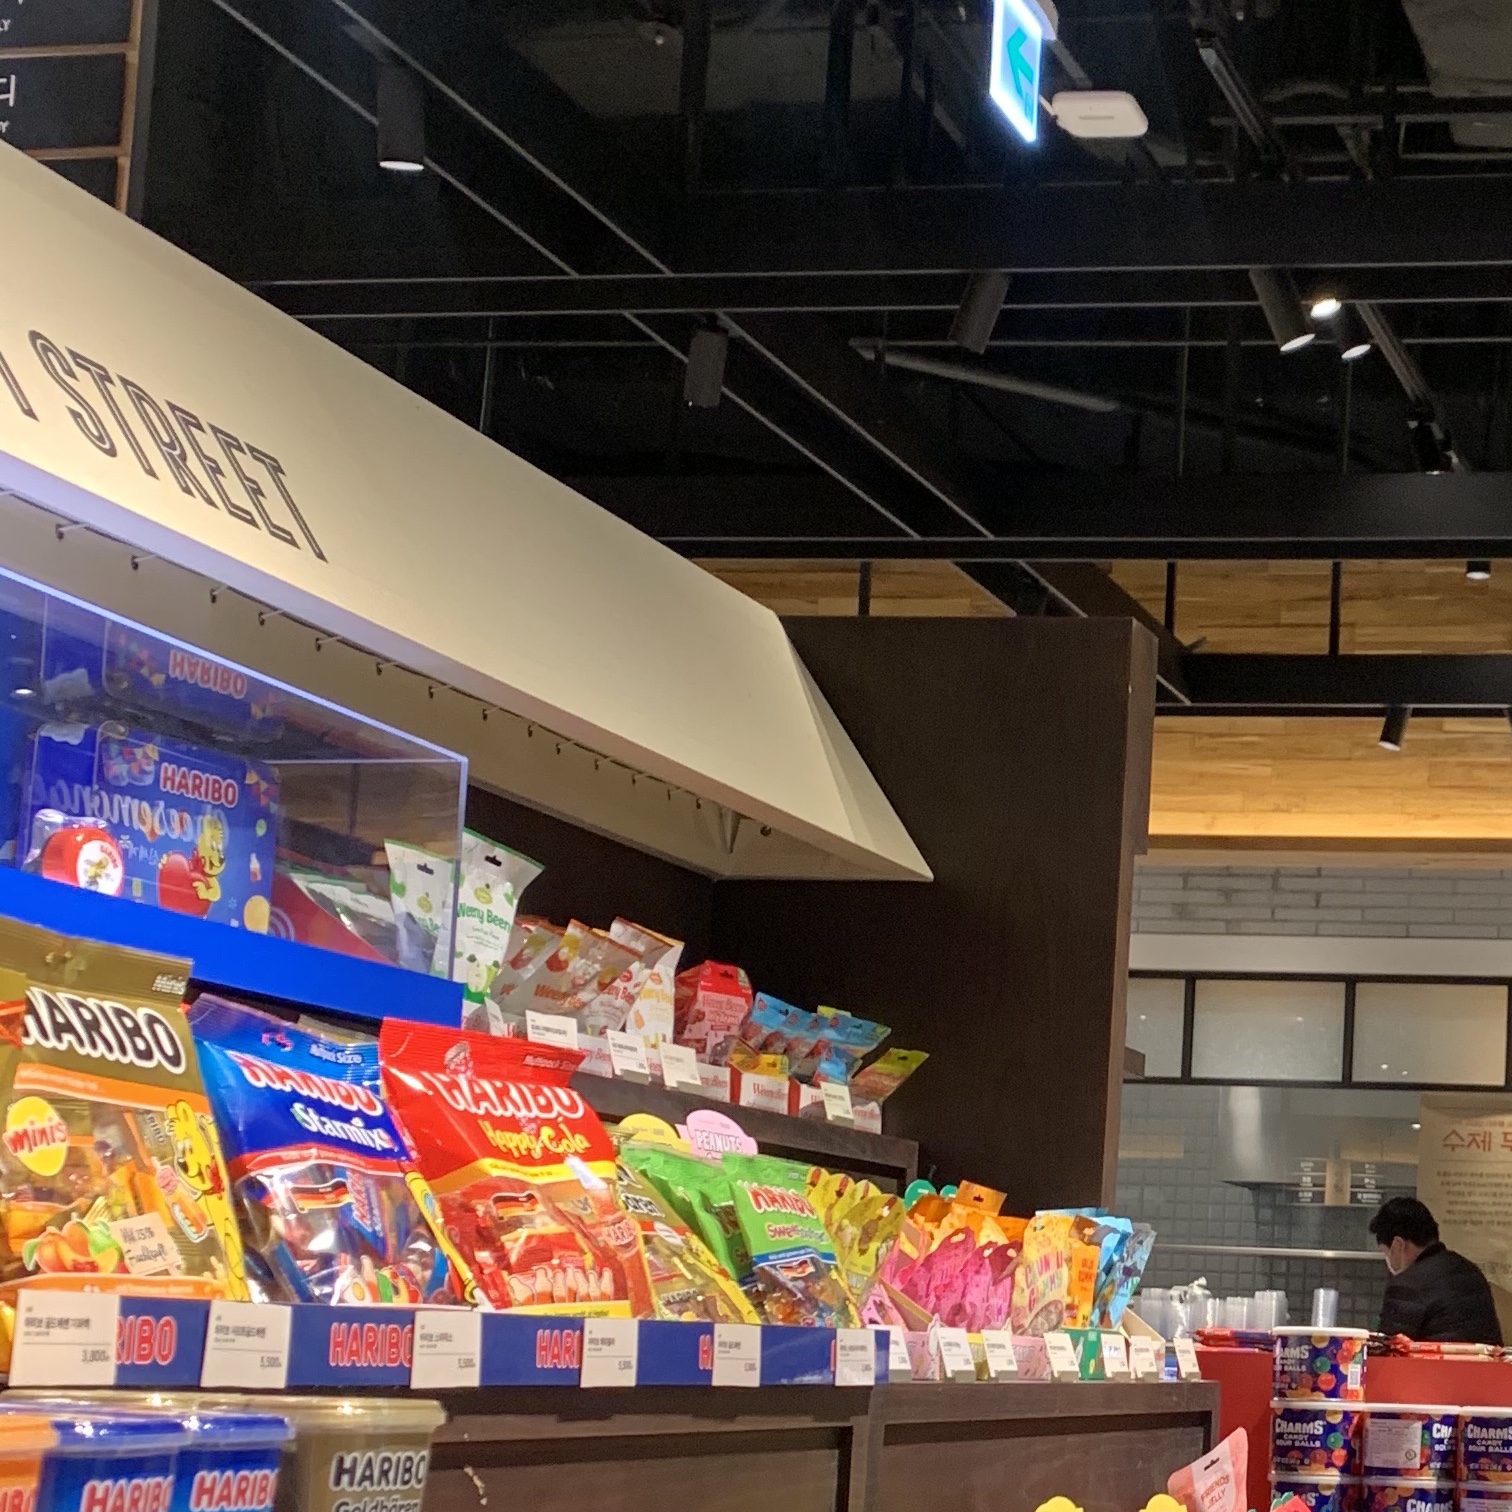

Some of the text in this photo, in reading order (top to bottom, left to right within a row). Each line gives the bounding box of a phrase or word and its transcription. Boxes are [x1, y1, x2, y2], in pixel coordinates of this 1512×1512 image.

[28, 330, 328, 563] STREET
[160, 762, 238, 809] HARIBO
[4, 1116, 68, 1155] minis
[292, 1102, 390, 1151] Starmix
[478, 1119, 541, 1159] Happy
[695, 1129, 743, 1152] PEANUTS
[1442, 1130, 1492, 1152] 수제
[116, 1315, 178, 1366] RIBO
[536, 1329, 583, 1369] HARI
[1277, 1344, 1309, 1360] ARMS
[1275, 1418, 1324, 1435] CHARMS
[1294, 1440, 1321, 1448] BALLS
[1432, 1423, 1453, 1438] CHA
[330, 1450, 428, 1491] HARIBO
[1200, 1474, 1230, 1503] FRIENDS
